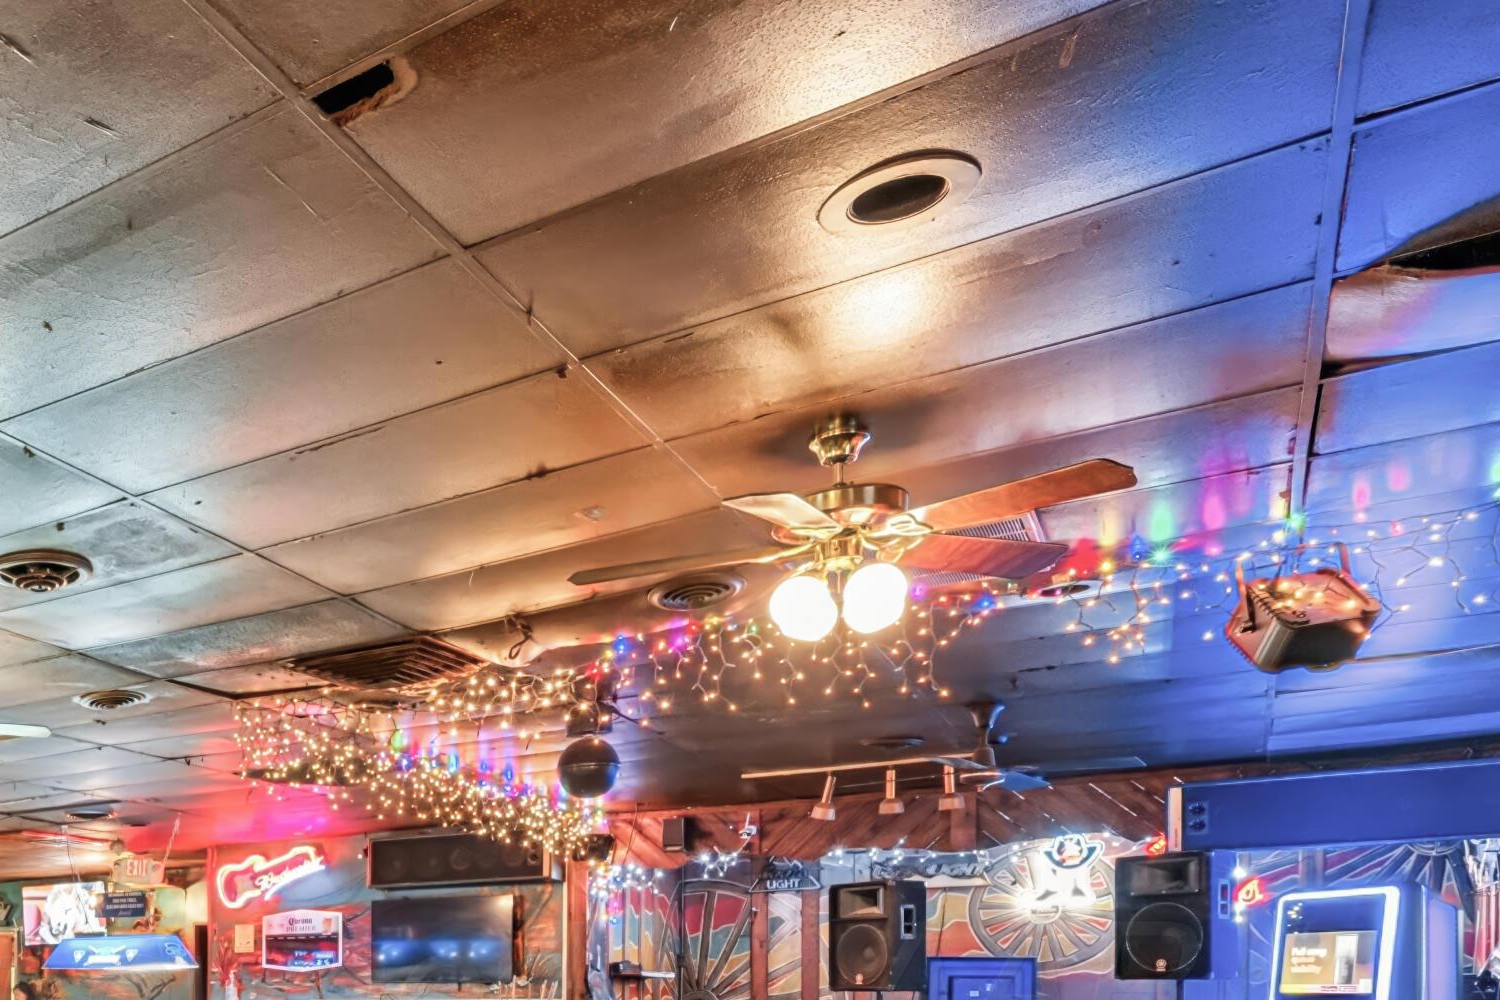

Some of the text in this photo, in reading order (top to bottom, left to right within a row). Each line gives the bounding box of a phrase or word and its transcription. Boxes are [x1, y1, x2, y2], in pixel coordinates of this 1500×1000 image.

[126, 860, 148, 877] EXIT
[766, 878, 801, 890] LIGHT
[288, 917, 313, 926] Corona
